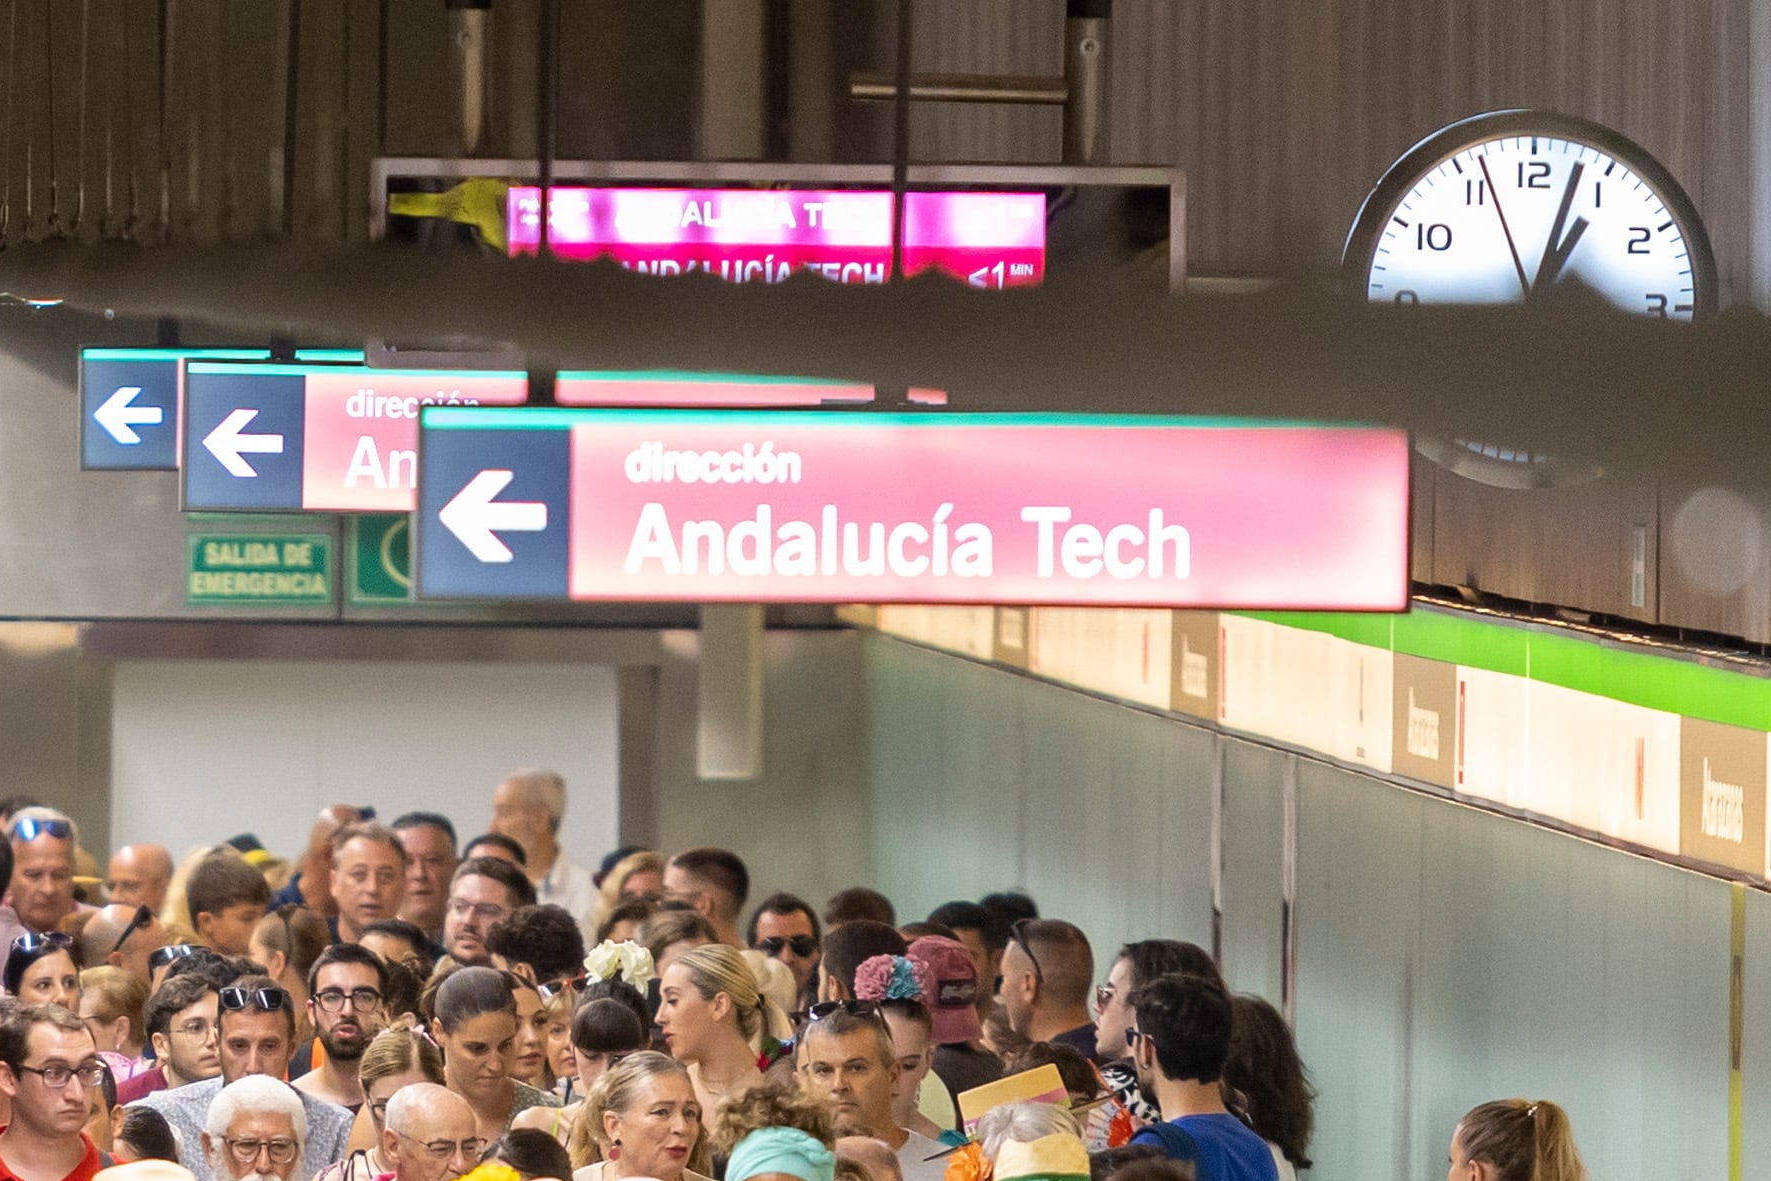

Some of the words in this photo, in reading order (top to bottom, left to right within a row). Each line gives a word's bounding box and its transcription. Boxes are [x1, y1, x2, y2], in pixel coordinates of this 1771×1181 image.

[1517, 161, 1552, 188] 12
[1417, 223, 1453, 251] 10
[1627, 227, 1651, 254] 2
[1009, 264, 1034, 276] MIN
[624, 441, 802, 484] dirección
[204, 541, 278, 567] SALIDA
[284, 541, 311, 567] DE
[623, 502, 994, 577] Andalucía
[1021, 505, 1190, 579] Tech
[192, 572, 327, 596] EMERGENCIA
